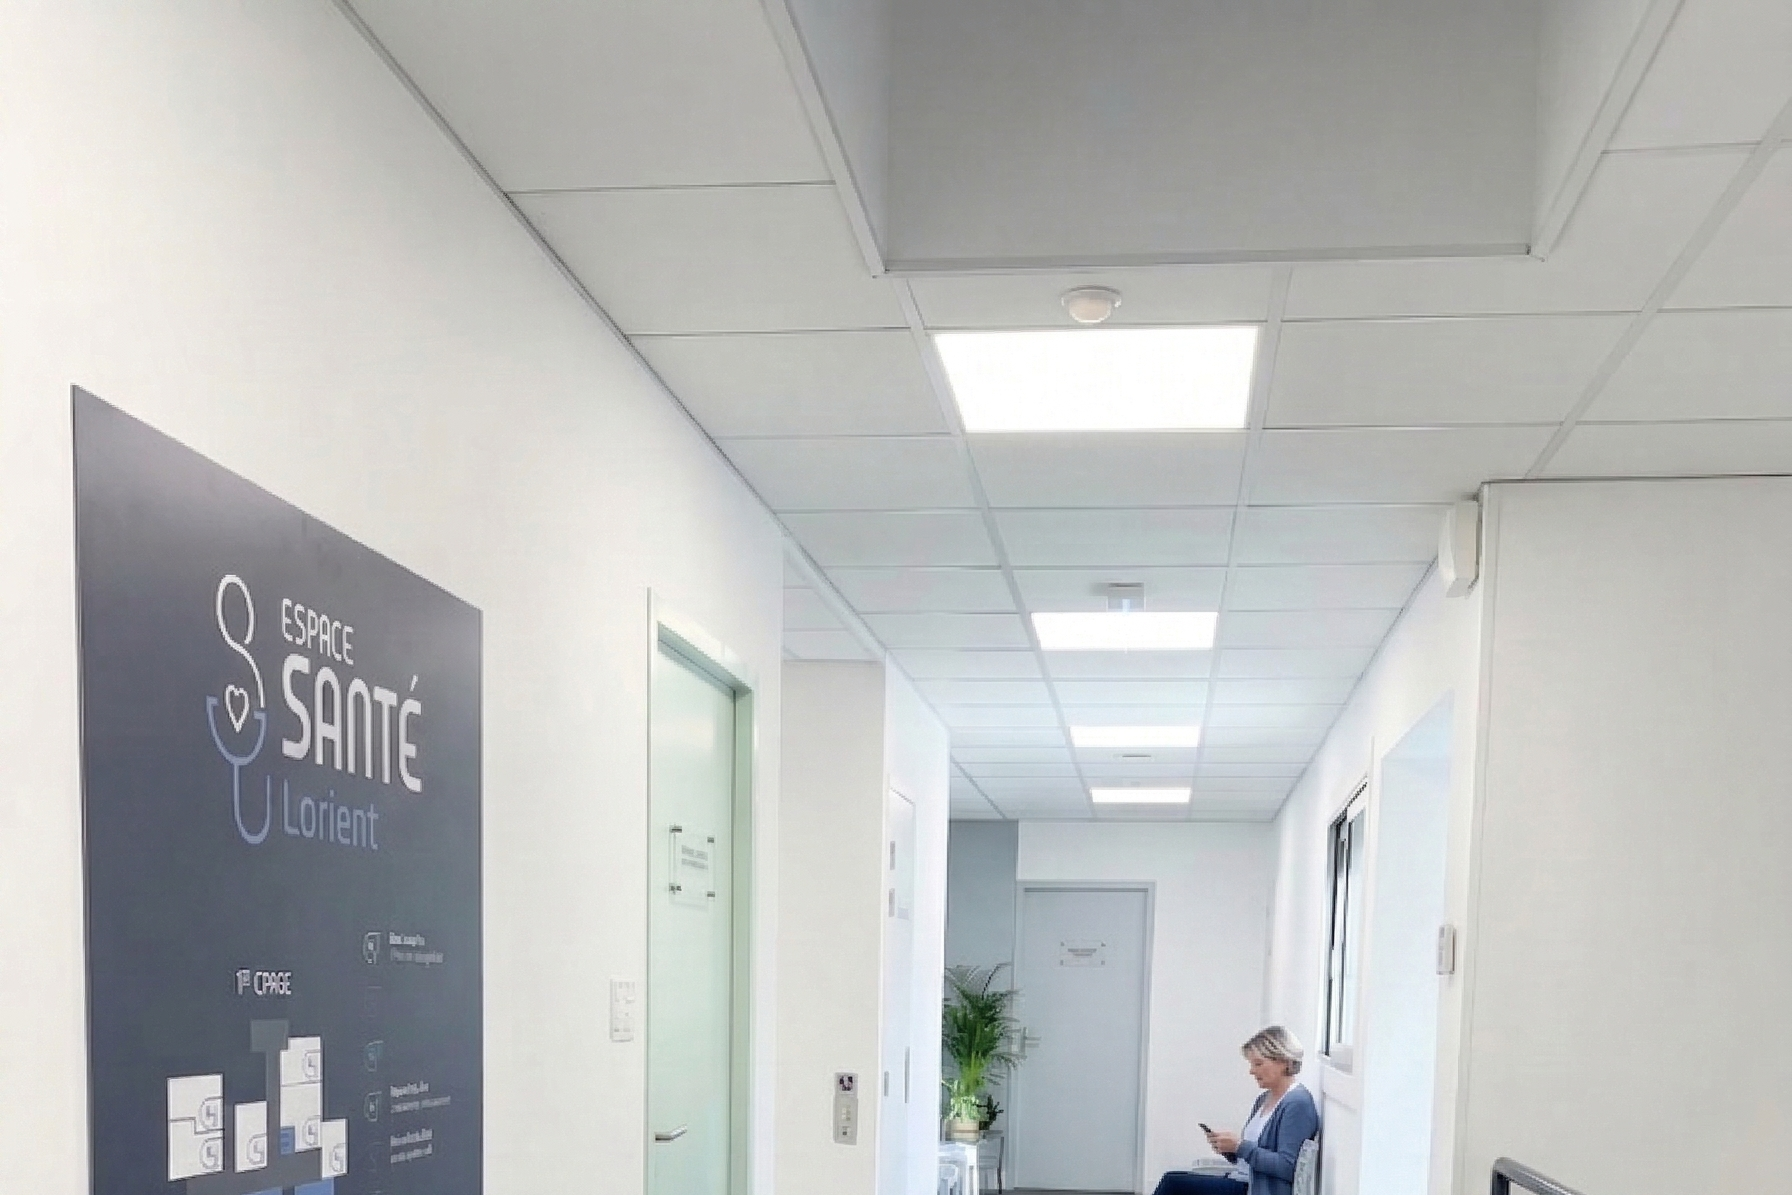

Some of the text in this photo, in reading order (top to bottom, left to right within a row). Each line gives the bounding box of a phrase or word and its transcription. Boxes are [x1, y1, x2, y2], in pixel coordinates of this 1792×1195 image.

[282, 598, 354, 665] ESPACE
[282, 653, 422, 793] SANTÉ
[283, 778, 379, 850] Lorient
